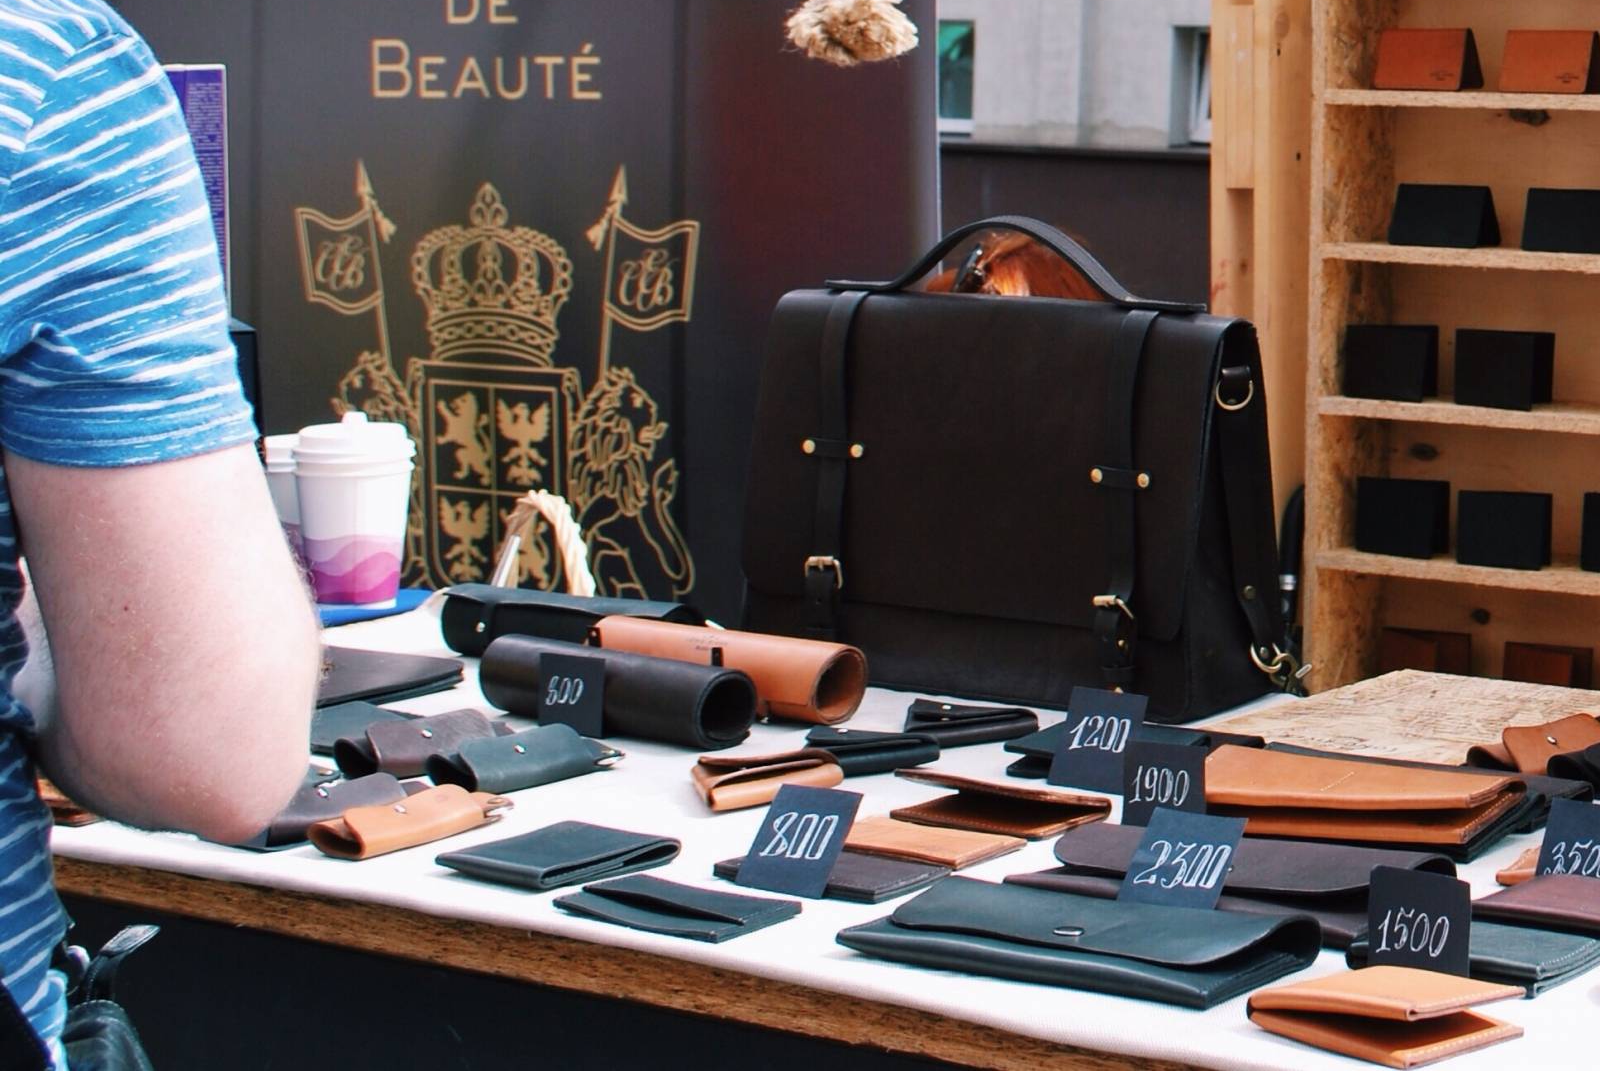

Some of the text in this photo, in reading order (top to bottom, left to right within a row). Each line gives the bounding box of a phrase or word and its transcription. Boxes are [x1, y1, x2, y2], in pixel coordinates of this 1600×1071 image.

[1068, 715, 1132, 754] 1200
[1129, 765, 1190, 807] 1900
[759, 811, 839, 860] 800
[1133, 840, 1232, 889] 2300
[1376, 906, 1450, 958] 1500
